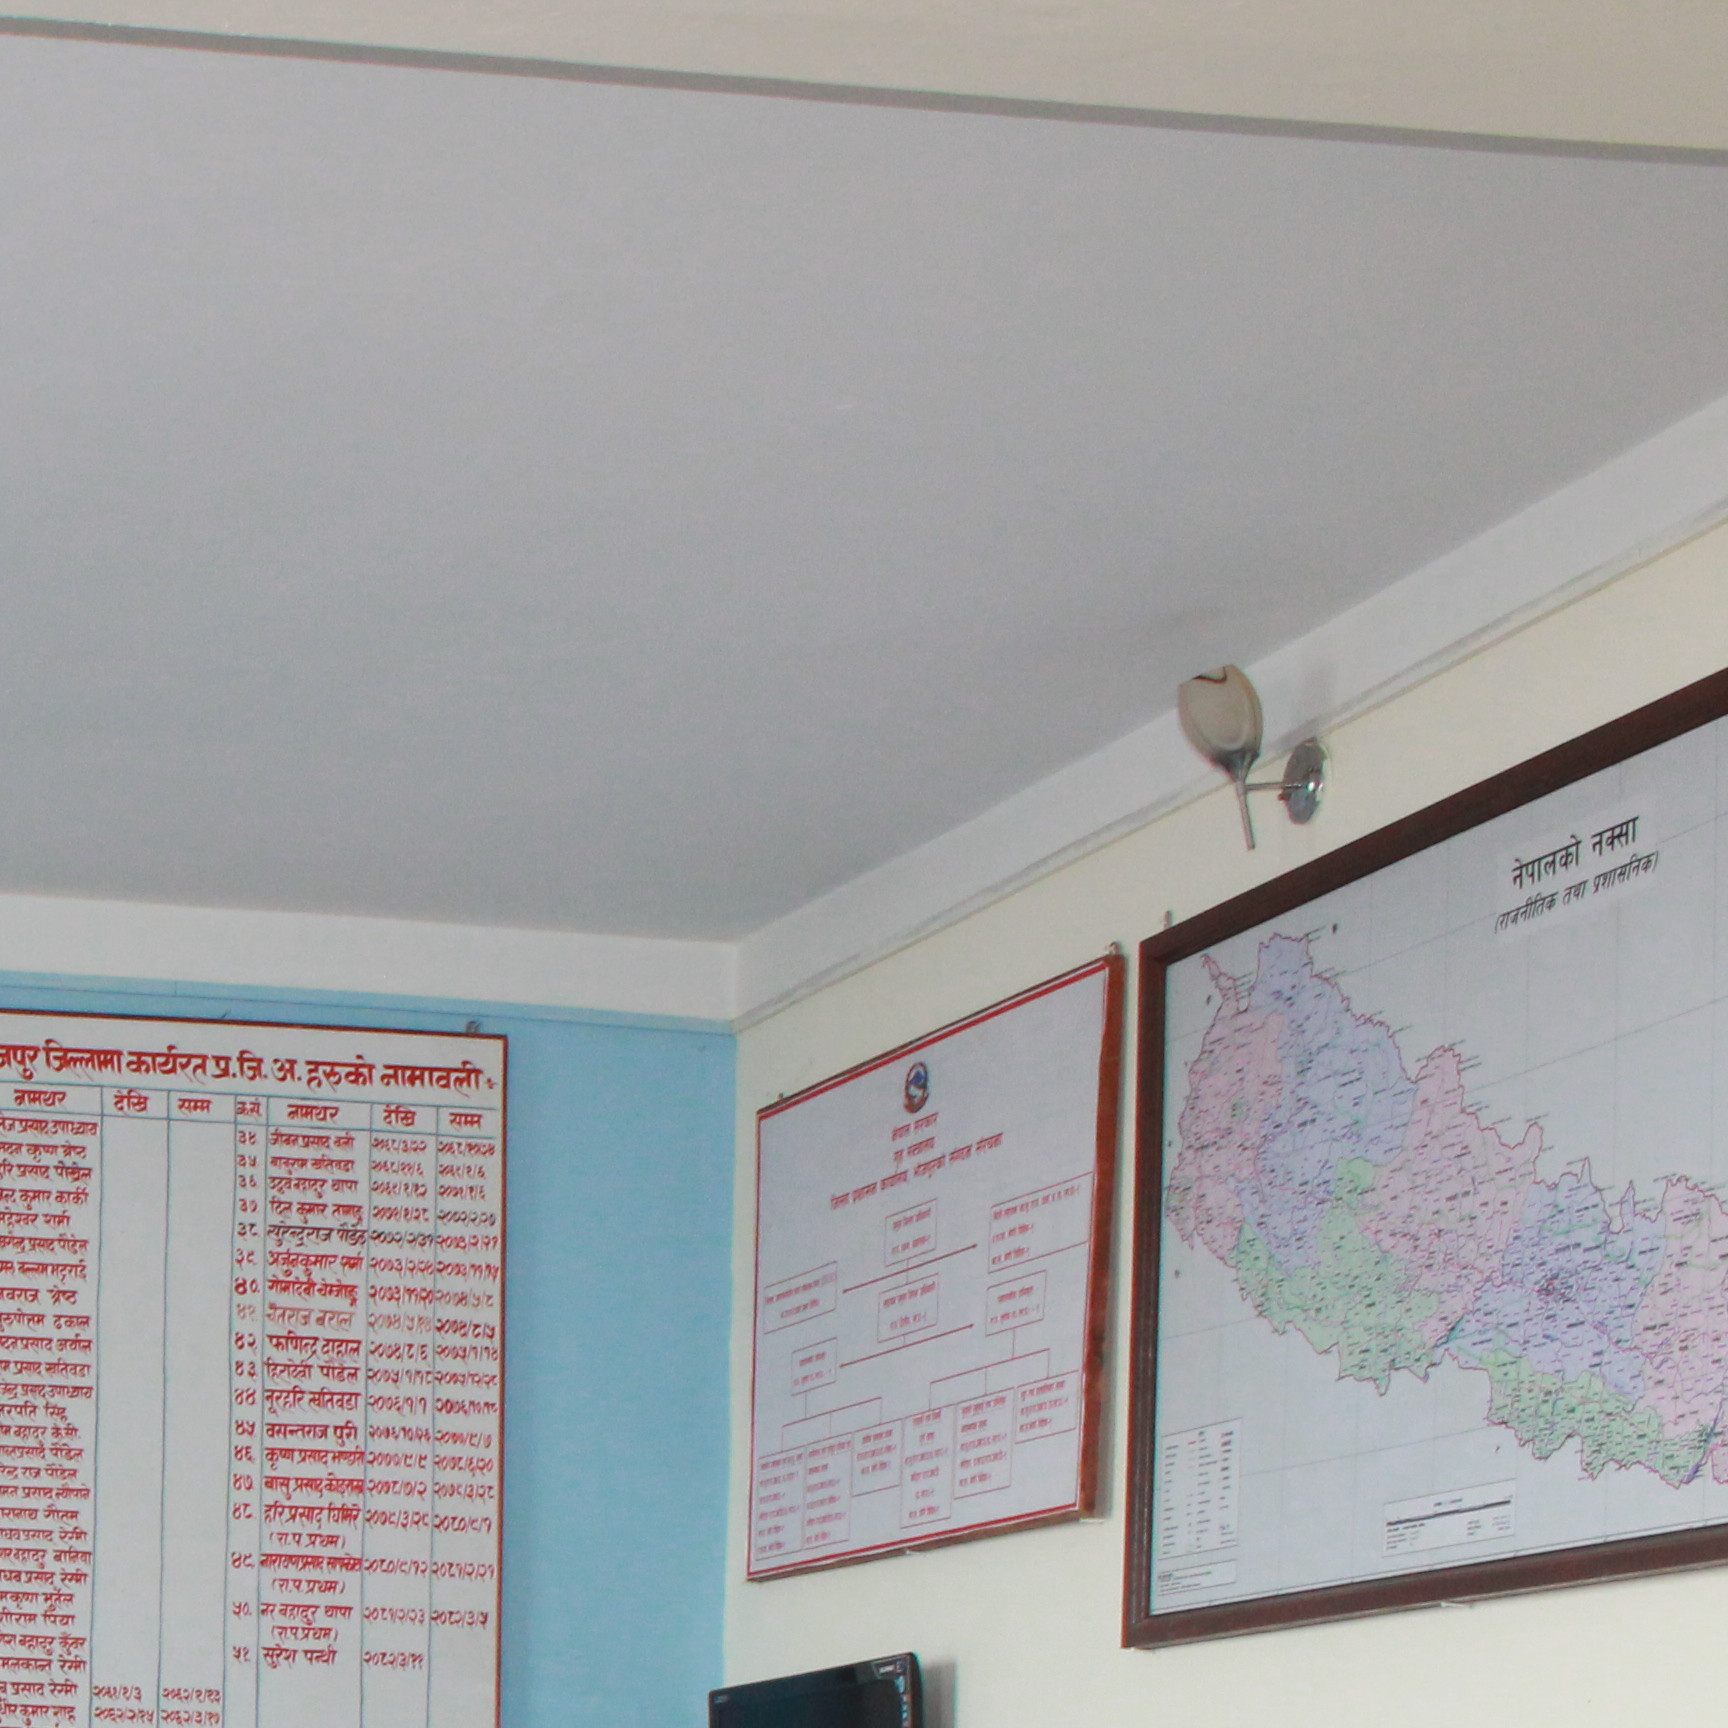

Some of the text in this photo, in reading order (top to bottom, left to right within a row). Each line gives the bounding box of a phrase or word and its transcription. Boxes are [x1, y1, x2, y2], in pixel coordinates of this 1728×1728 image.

[1511, 816, 1639, 889] नेपालको नक्सा
[1494, 851, 1658, 934] (राजनीतिक तथा प्रशासनिक)
[44, 1039, 124, 1081] जिल्लामा
[126, 1045, 209, 1085] कार्यरत
[114, 1089, 149, 1112] देखि
[178, 1098, 212, 1114] सम्म
[383, 1105, 416, 1127] देखि
[449, 1112, 482, 1128] सम्म
